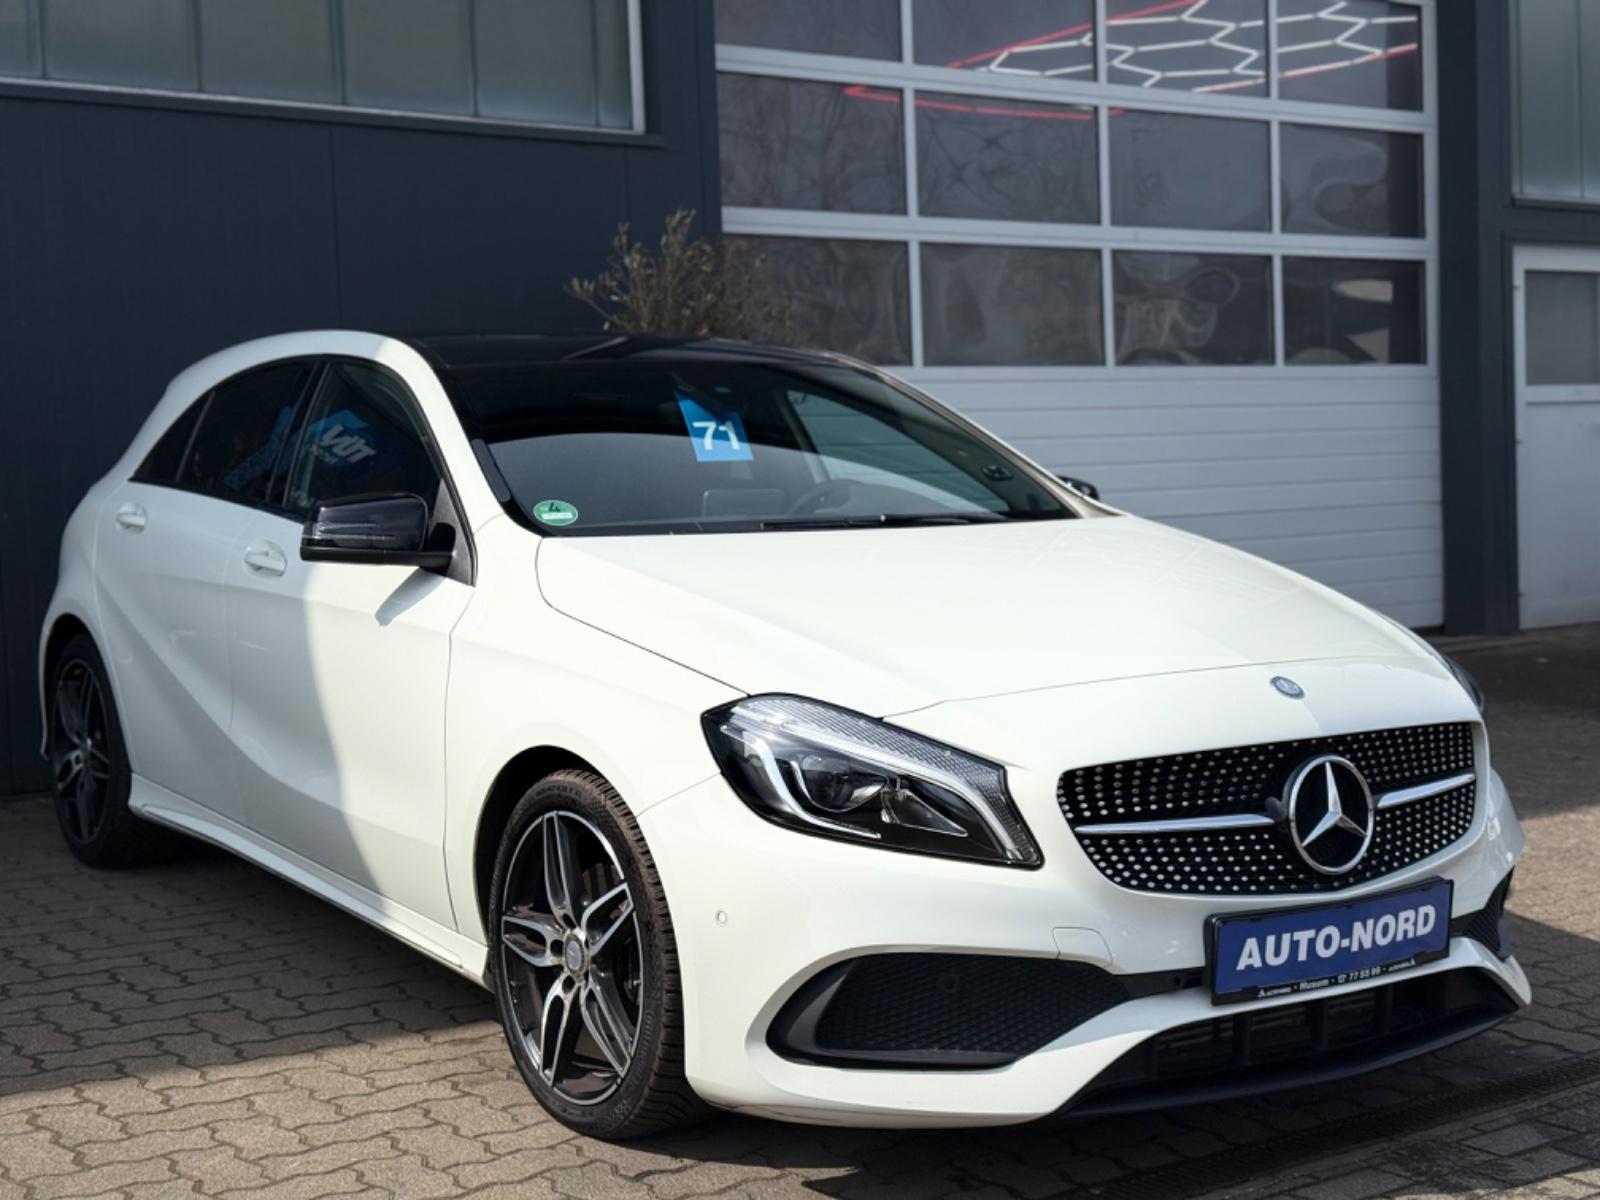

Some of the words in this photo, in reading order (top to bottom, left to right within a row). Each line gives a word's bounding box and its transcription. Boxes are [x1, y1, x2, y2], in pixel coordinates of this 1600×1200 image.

[692, 420, 741, 451] 71
[548, 502, 561, 513] 4
[1236, 904, 1436, 971] AUTO-NORD
